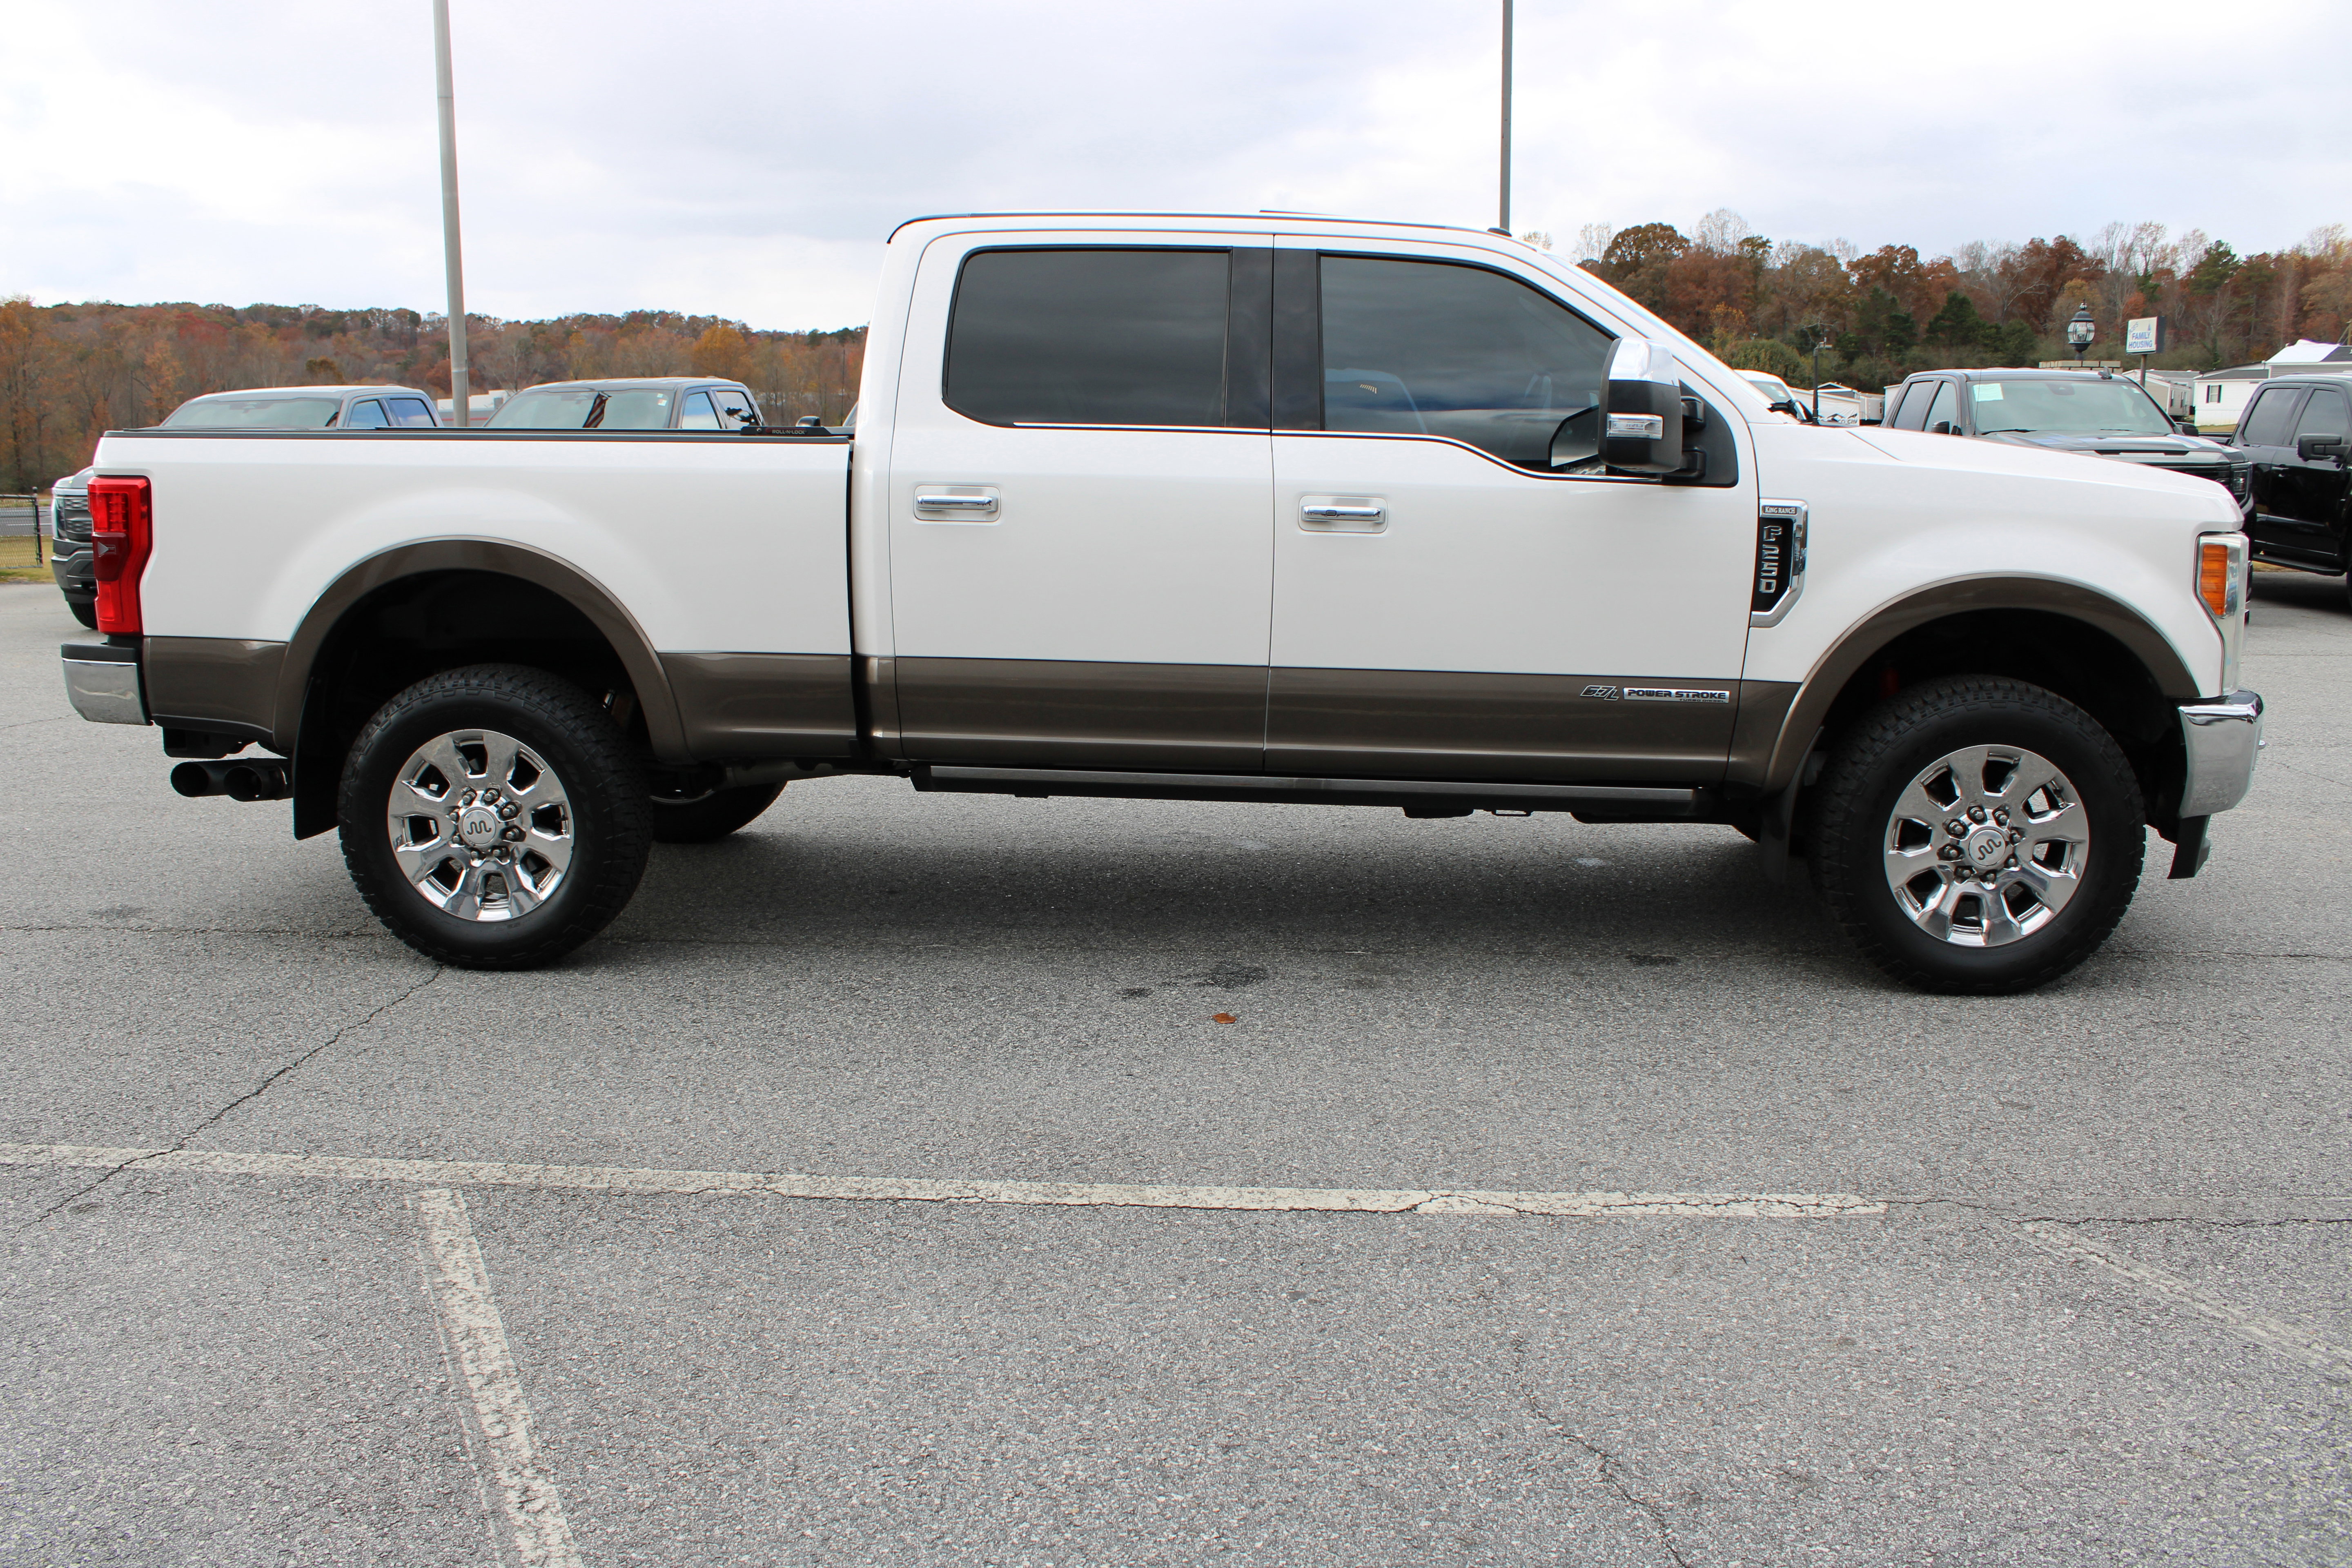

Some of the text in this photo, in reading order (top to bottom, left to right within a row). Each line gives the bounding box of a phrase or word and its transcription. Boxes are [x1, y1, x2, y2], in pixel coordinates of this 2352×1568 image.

[2132, 332, 2151, 340] FAMILY
[2128, 340, 2152, 348] HOUSING
[1628, 689, 1672, 697] POWER
[1675, 691, 1726, 699] STROKE
